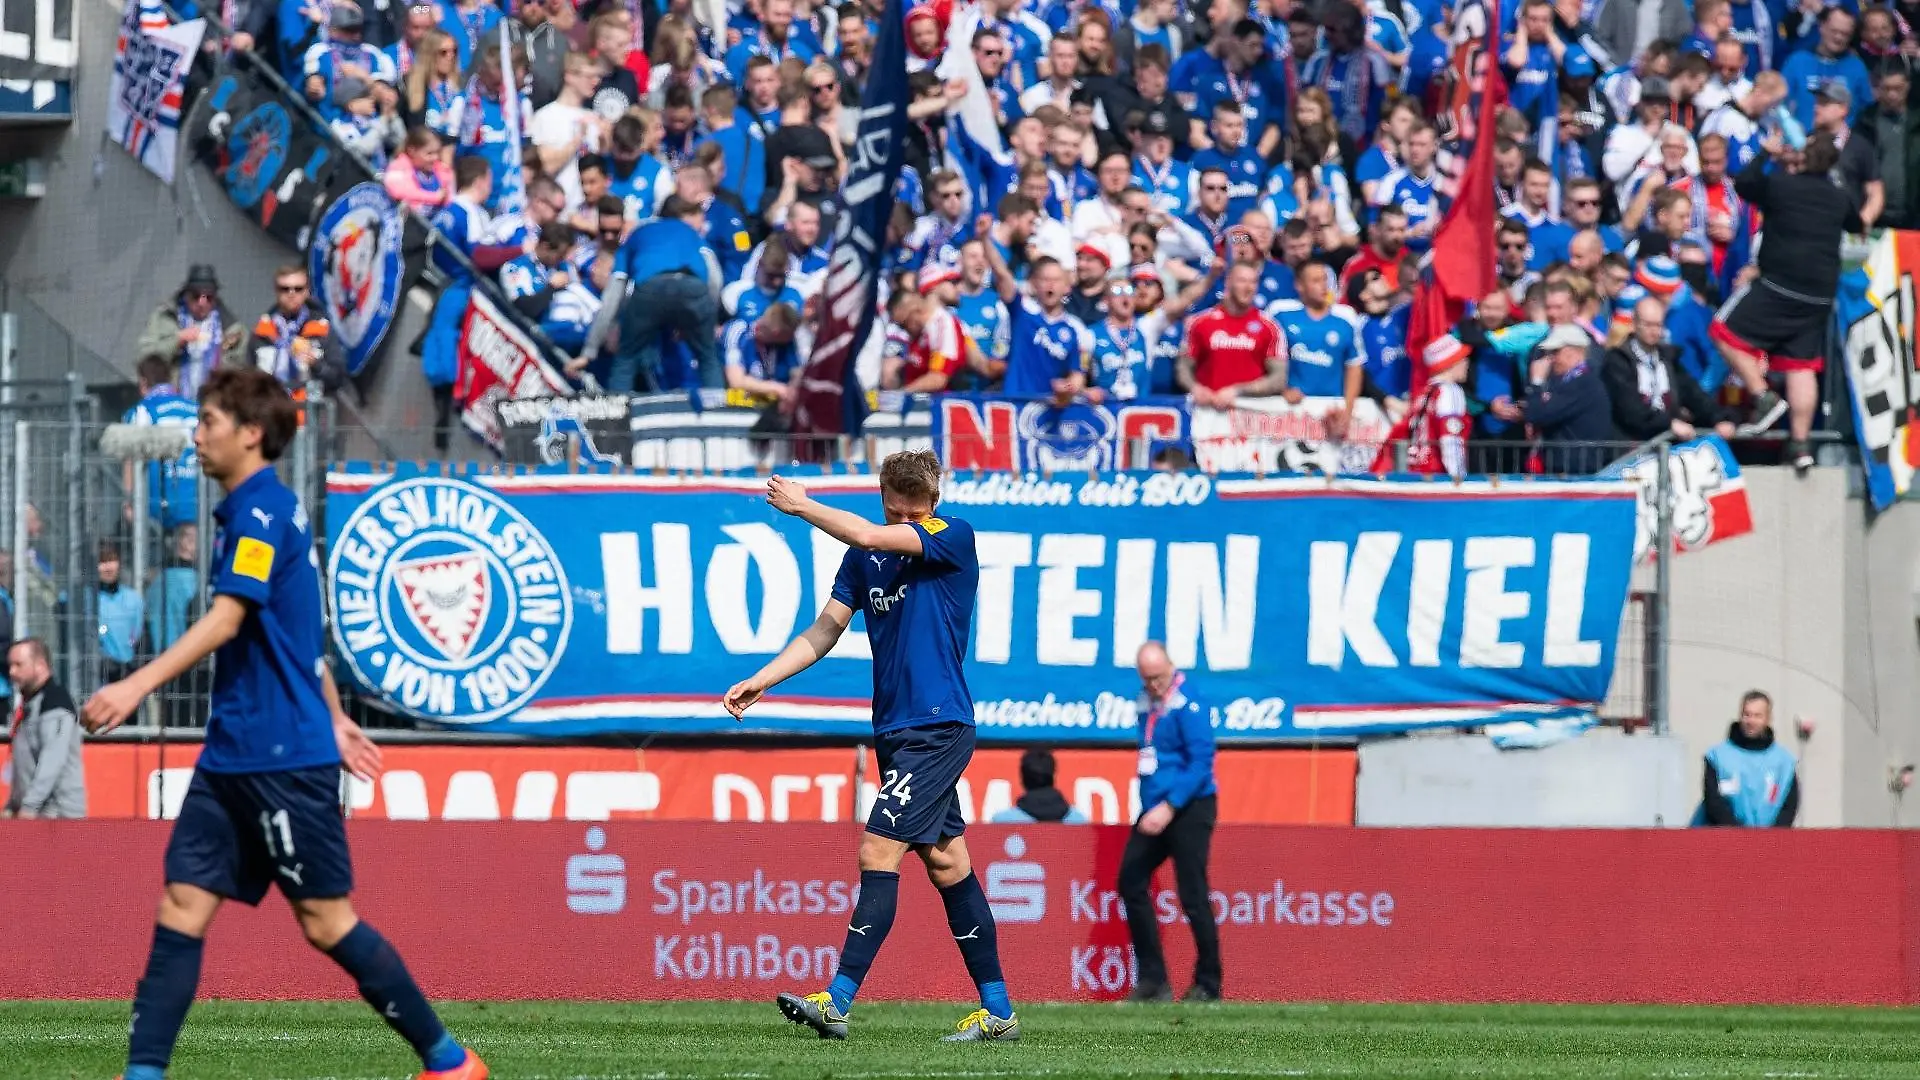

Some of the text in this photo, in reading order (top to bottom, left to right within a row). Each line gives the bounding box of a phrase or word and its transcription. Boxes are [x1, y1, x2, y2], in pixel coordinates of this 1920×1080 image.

[338, 515, 398, 651] KIELER
[435, 486, 562, 625] HOLSTEIN
[601, 522, 1602, 670] HOLTEIN KIEL
[381, 636, 550, 714] VON 1900
[878, 769, 913, 806] 24
[259, 808, 296, 858] 11
[654, 931, 840, 980] KölnBon
